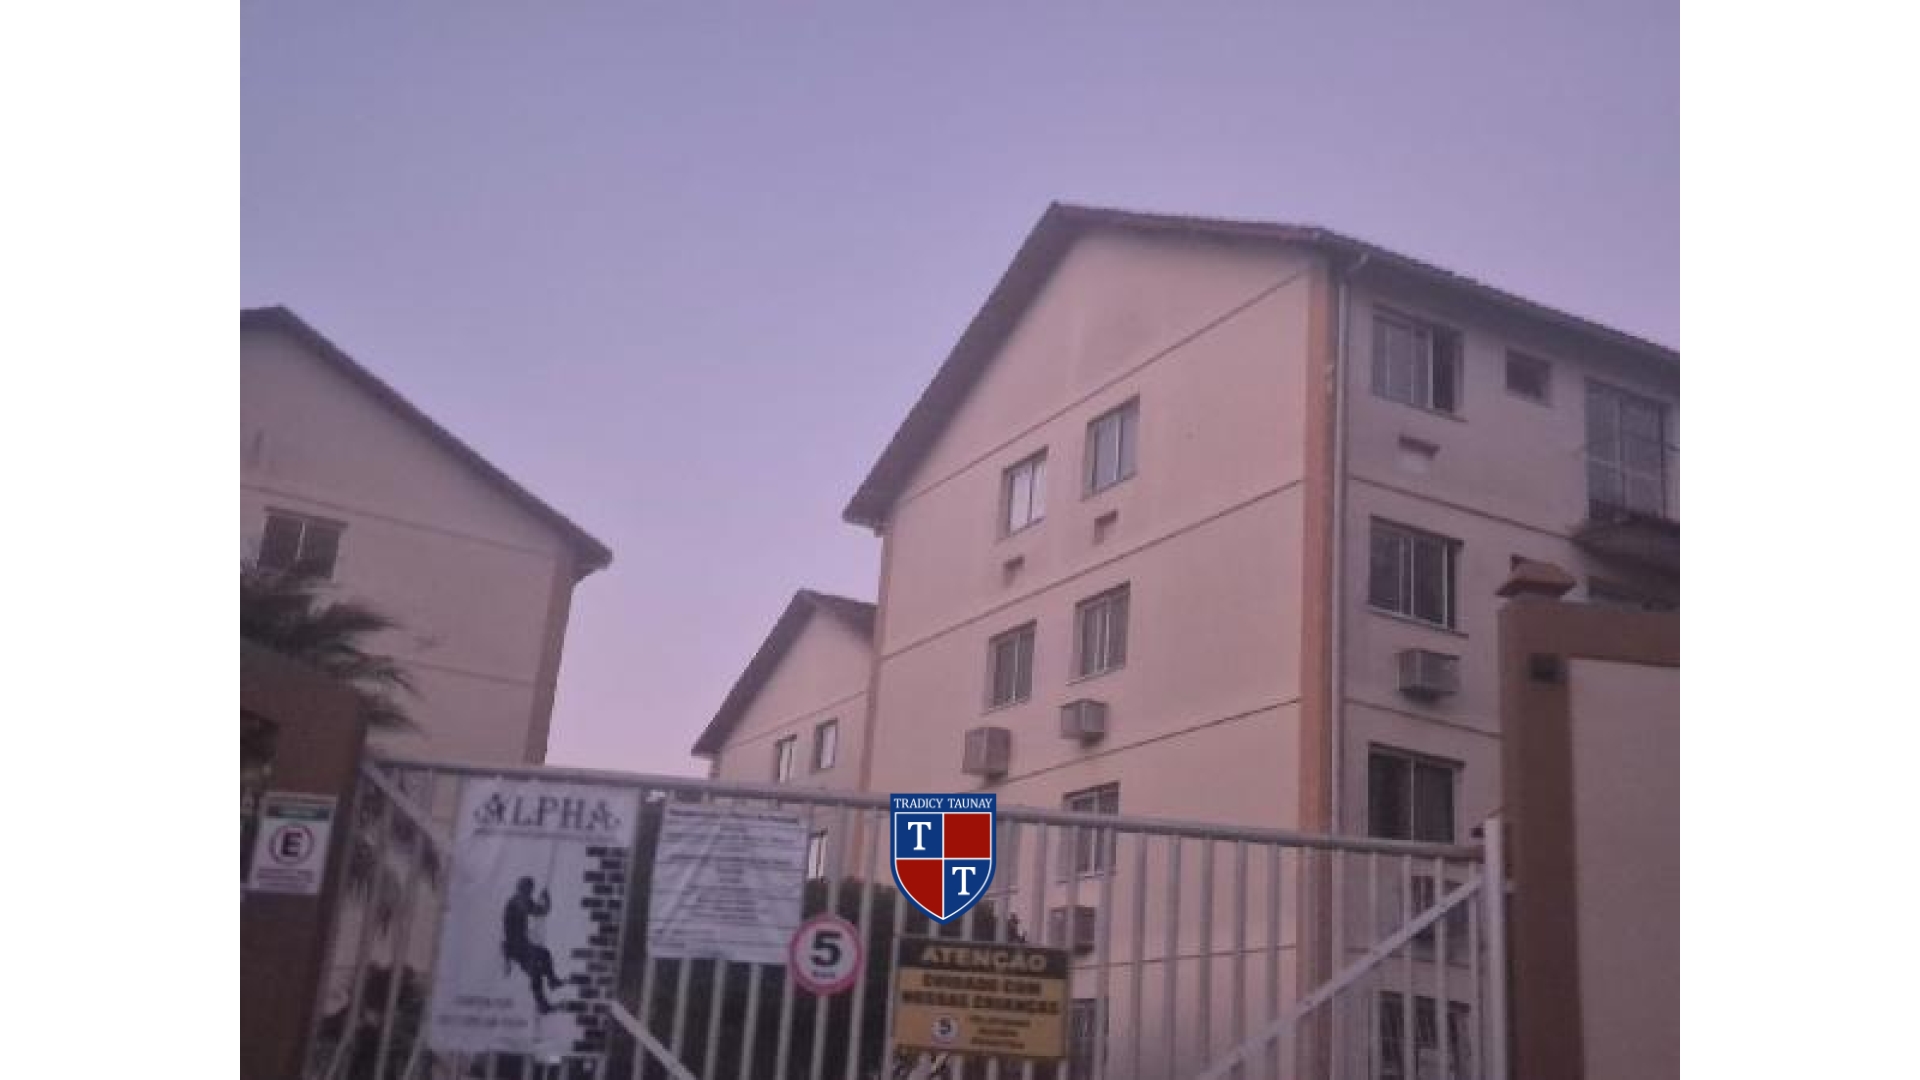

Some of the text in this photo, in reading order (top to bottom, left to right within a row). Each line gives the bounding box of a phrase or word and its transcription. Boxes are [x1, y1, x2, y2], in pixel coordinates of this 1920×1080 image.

[473, 792, 621, 830] ALPHA
[282, 832, 303, 857] E
[811, 931, 842, 967] 5
